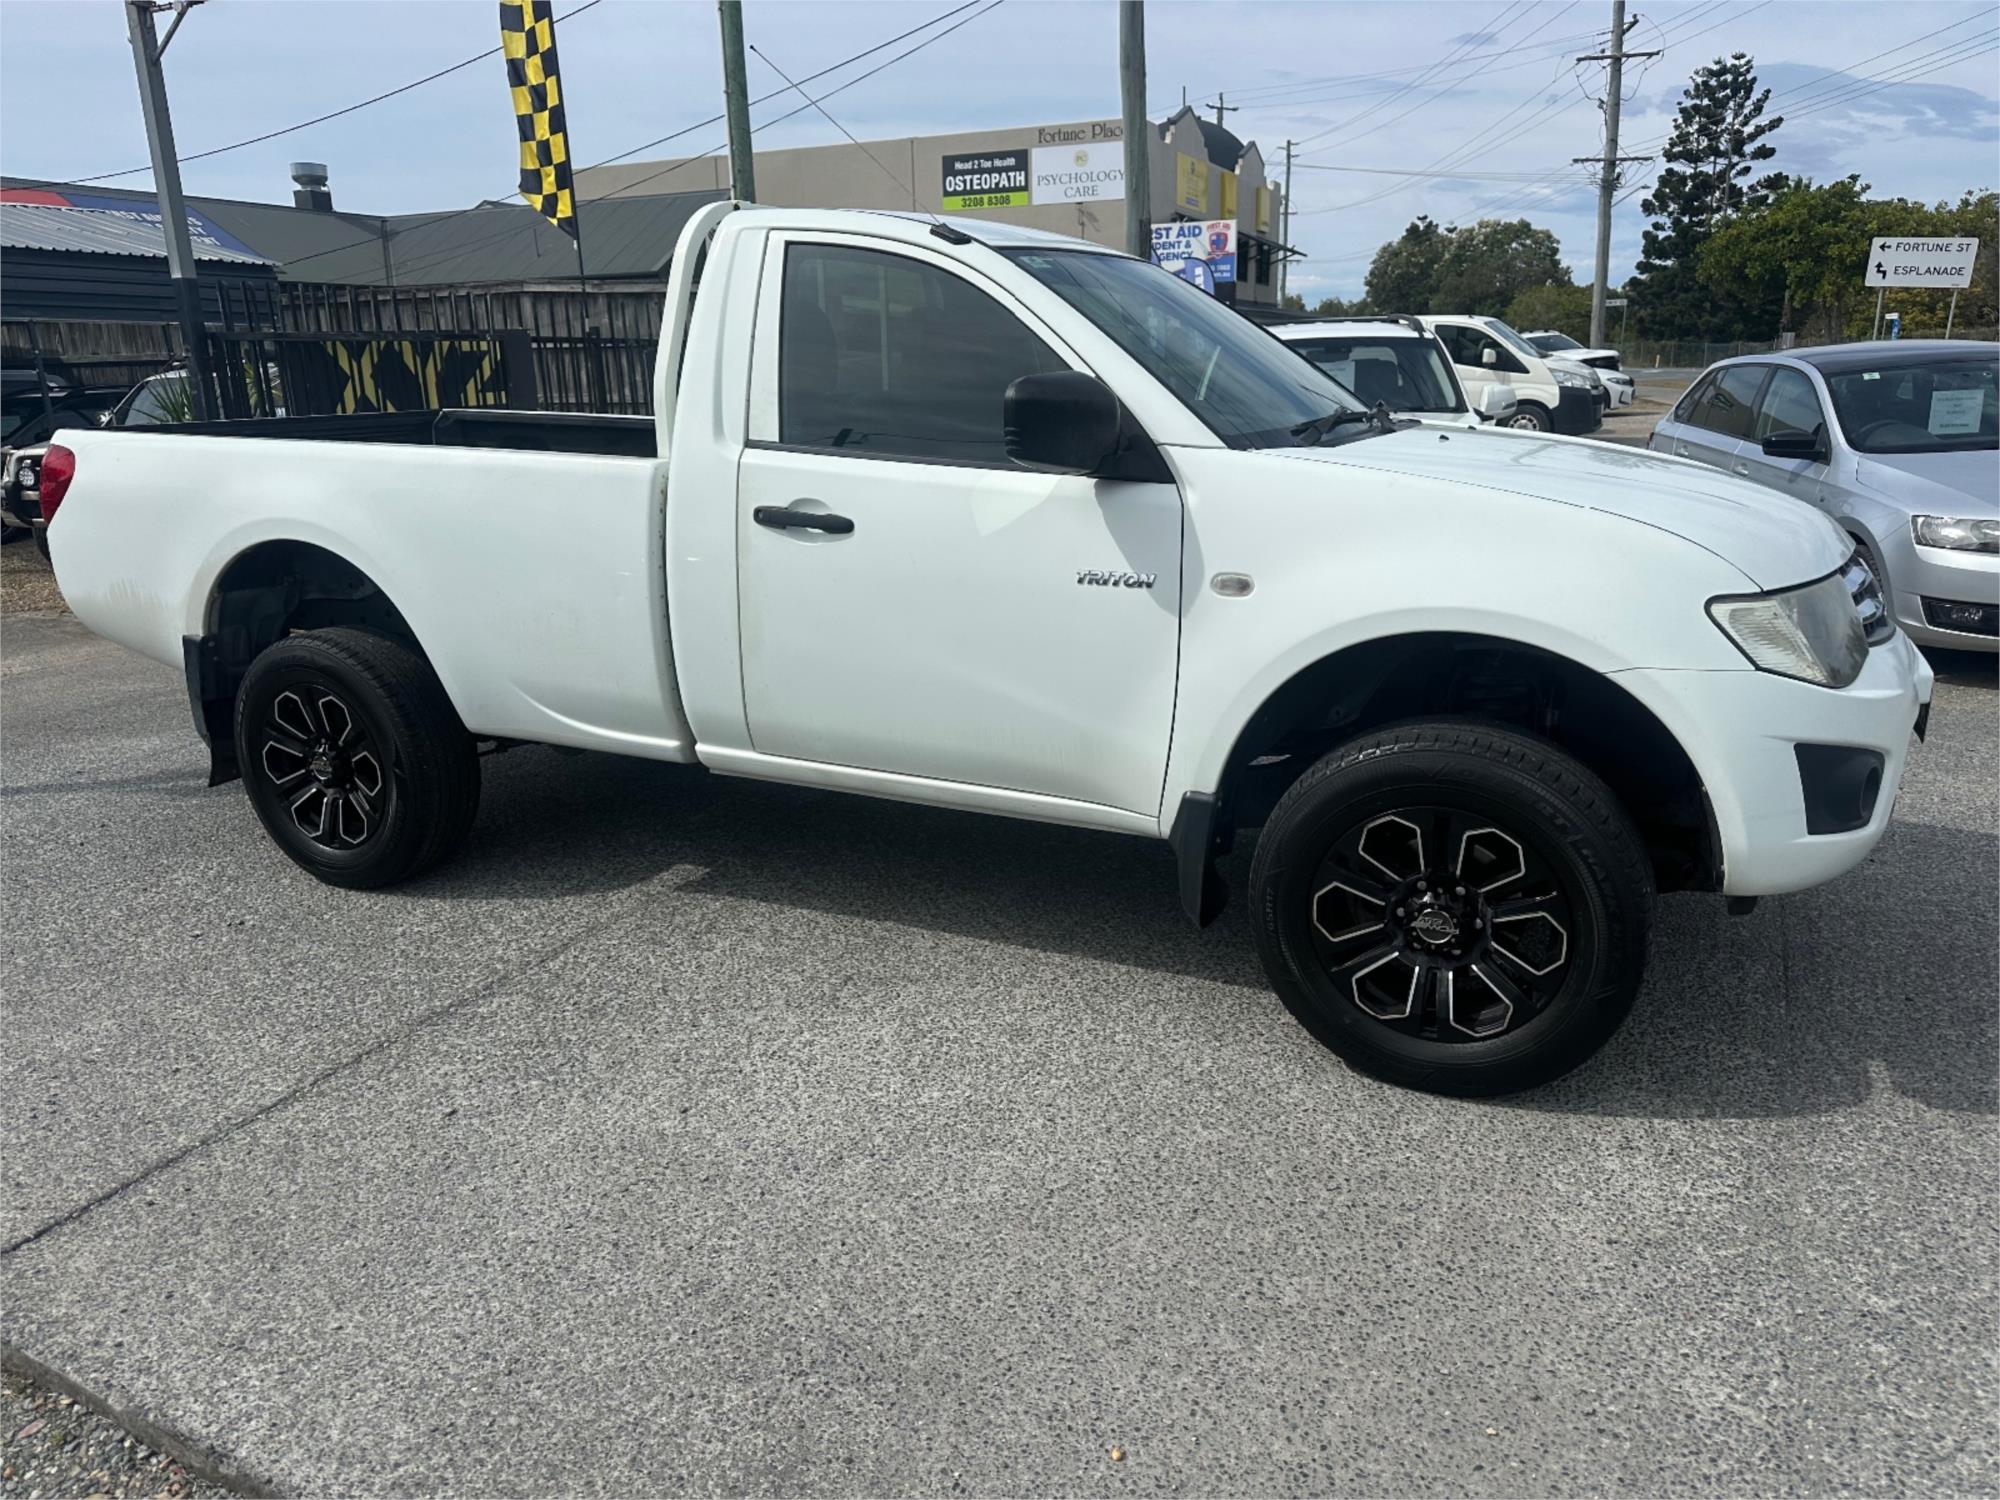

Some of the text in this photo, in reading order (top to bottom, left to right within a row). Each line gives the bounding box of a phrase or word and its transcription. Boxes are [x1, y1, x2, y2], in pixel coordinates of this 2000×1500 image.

[1038, 123, 1124, 144] Fortune Plac
[954, 156, 1016, 170] Head 2 Toe Health
[945, 171, 1026, 191] OSTEOPATH
[1037, 169, 1125, 186] PSYCHOLOGY
[1064, 185, 1099, 198] CARE
[961, 196, 984, 207] 3208
[1176, 224, 1202, 239] AID
[1184, 240, 1192, 249] &
[1895, 242, 1972, 252] FORTUNE ST
[1159, 250, 1194, 261] GENCY
[1893, 265, 1966, 276] ESPLANADE
[1077, 569, 1157, 589] TRITON
